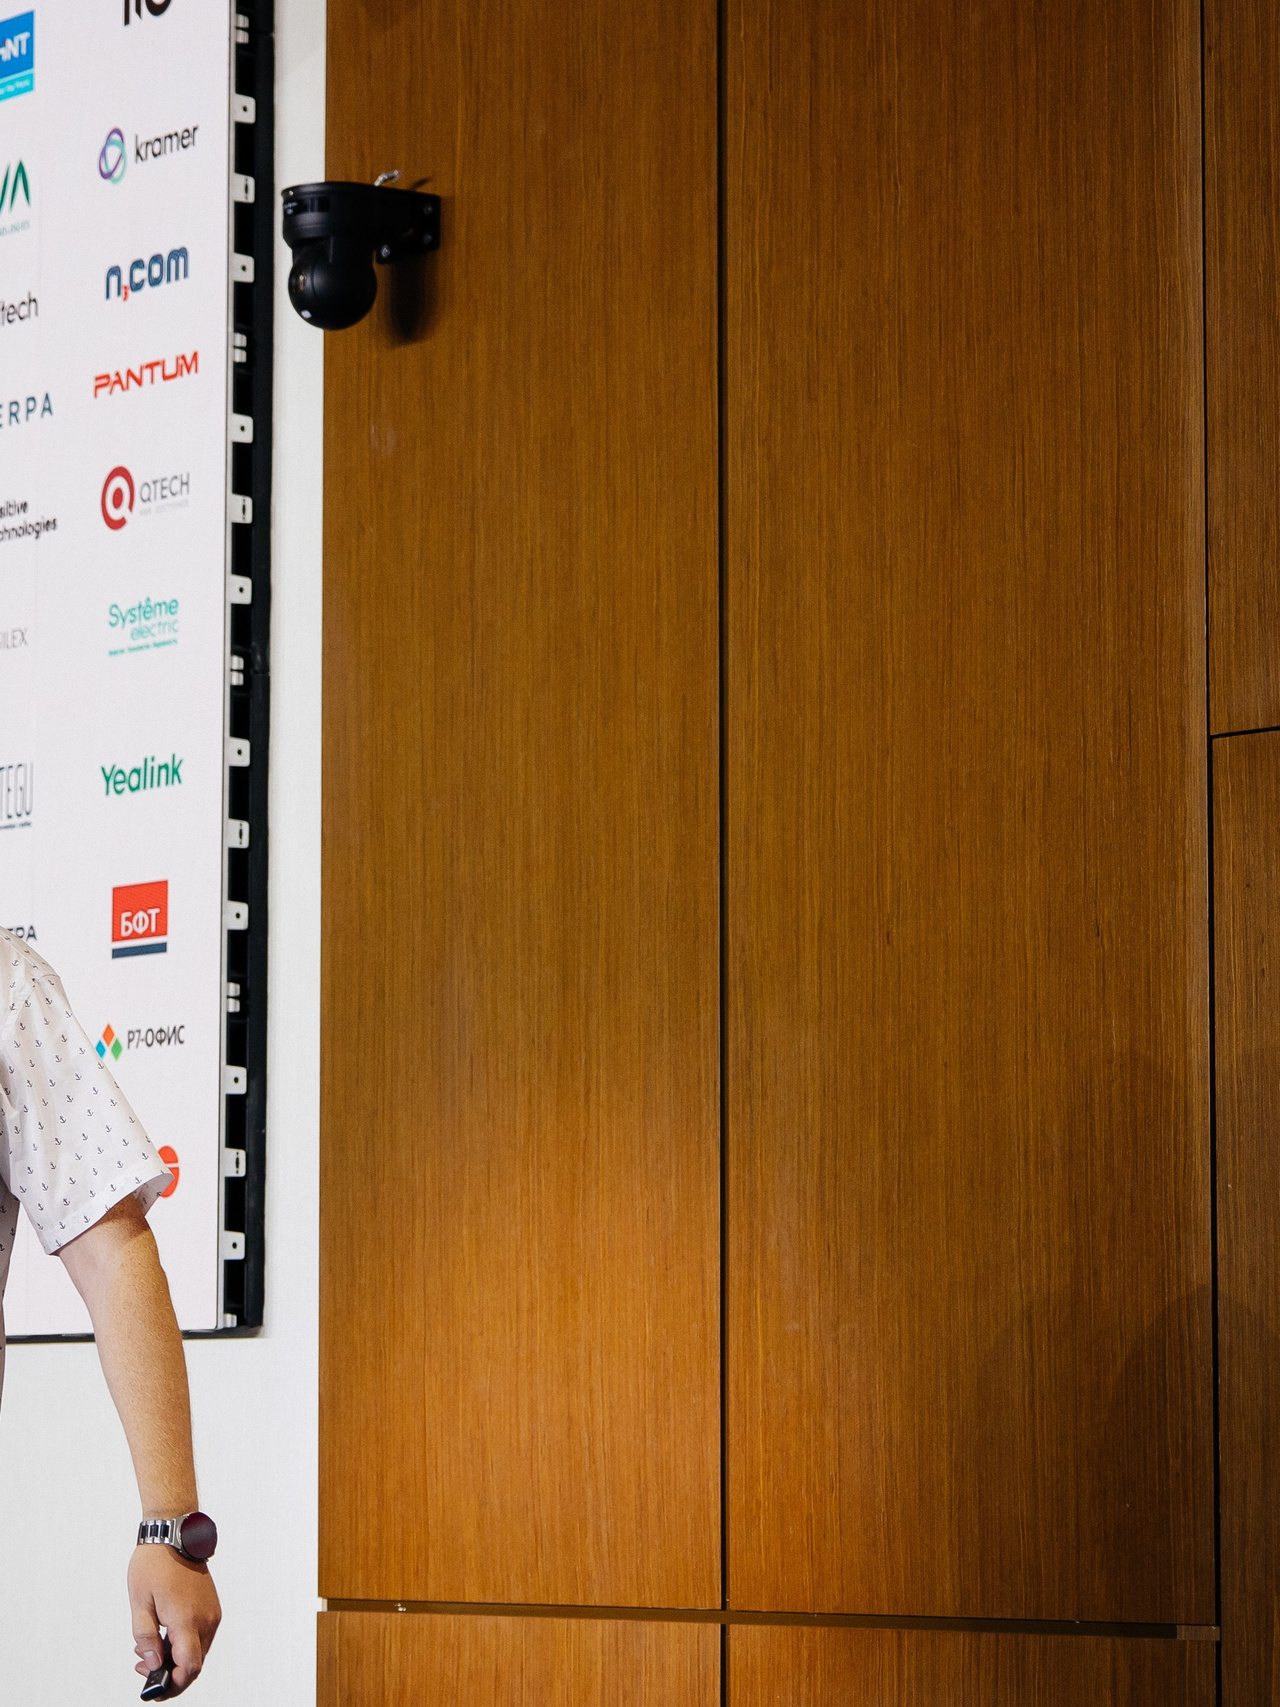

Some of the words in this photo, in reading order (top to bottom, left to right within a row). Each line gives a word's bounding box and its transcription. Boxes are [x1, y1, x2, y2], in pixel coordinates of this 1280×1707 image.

[134, 125, 198, 163] kramer
[94, 350, 199, 399] PANTUM
[139, 472, 190, 503] QTECH
[0, 762, 33, 820] TEGU
[101, 753, 184, 796] Yealink
[120, 908, 161, 937] БФТ
[127, 1024, 185, 1049] Р7-ОФИС
